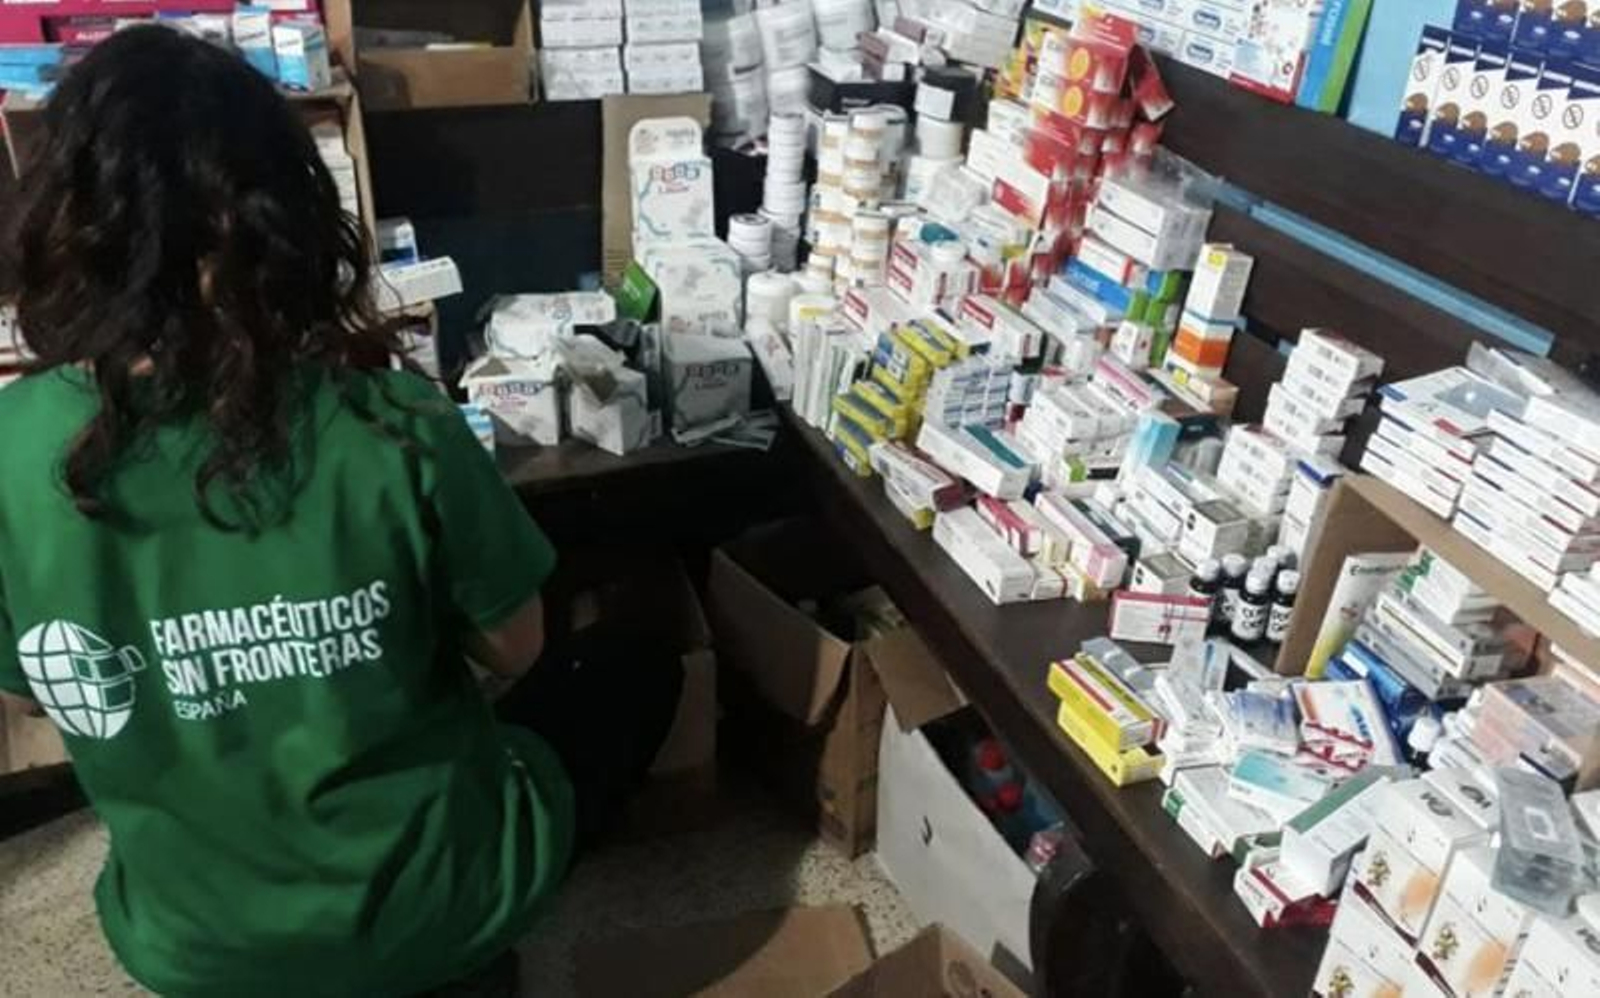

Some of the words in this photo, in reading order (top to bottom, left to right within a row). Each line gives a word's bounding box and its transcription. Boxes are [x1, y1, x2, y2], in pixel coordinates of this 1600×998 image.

[150, 580, 390, 656] FARMACÉUTICOS
[162, 656, 208, 695] SIN
[211, 628, 382, 687] FRONTERAS
[173, 690, 247, 720] ESPAÑA
